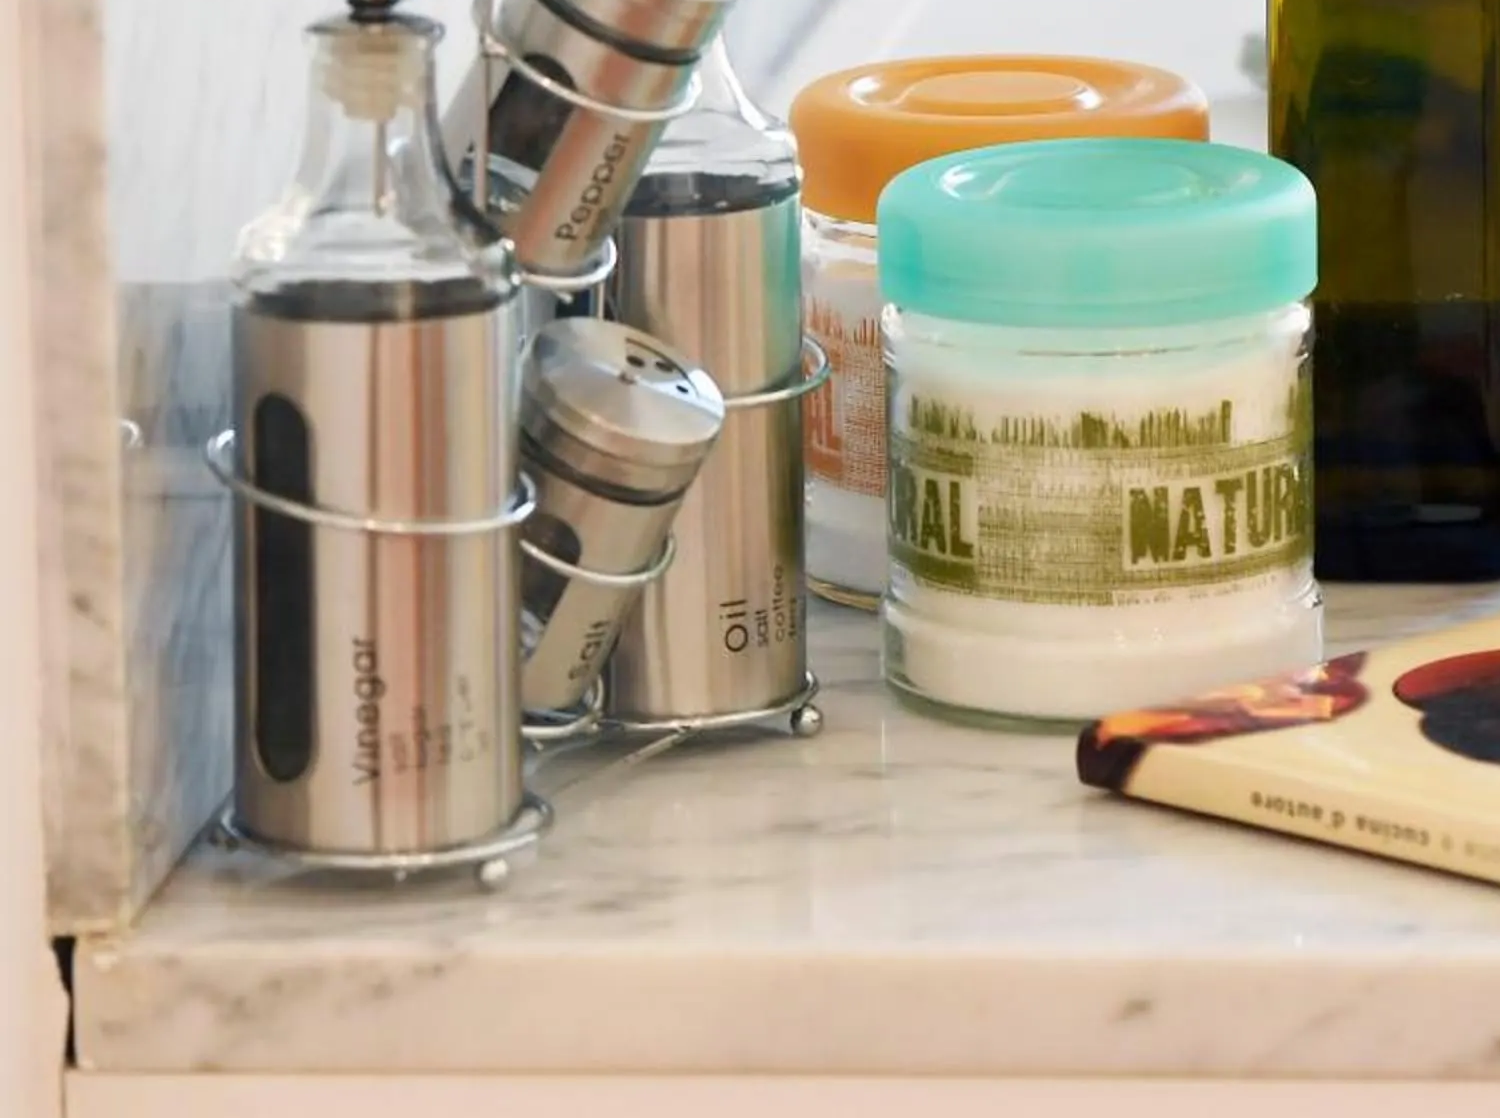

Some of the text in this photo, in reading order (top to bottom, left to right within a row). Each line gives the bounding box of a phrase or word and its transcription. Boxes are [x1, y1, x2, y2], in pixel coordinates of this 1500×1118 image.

[555, 133, 632, 241] Pepper
[719, 599, 748, 652] Oil
[352, 634, 387, 786] Vinegar
